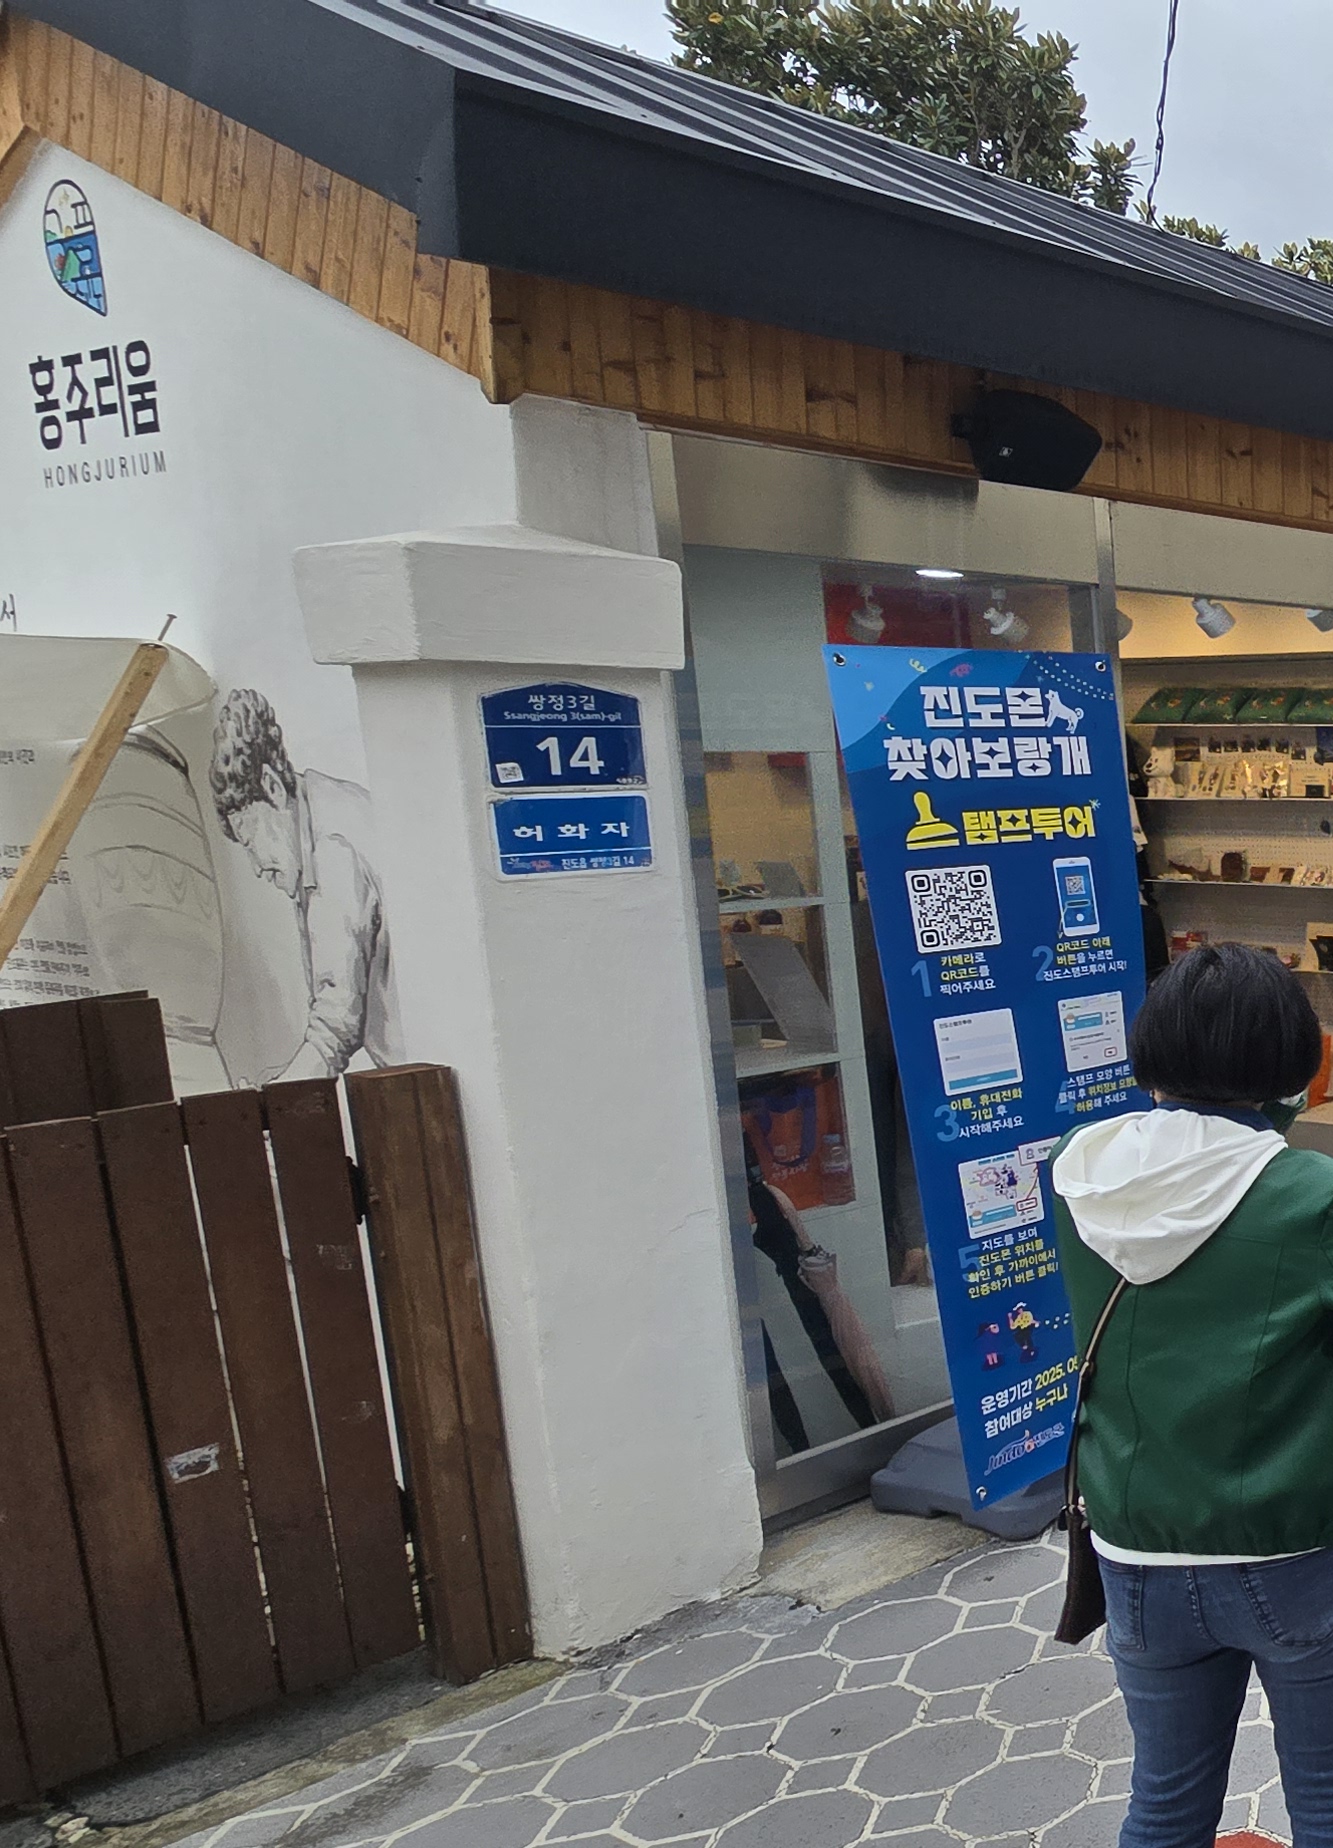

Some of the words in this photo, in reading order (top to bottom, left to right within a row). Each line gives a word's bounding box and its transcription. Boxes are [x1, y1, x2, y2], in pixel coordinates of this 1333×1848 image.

[29, 340, 161, 450] 홍주리움
[43, 450, 167, 488] HONGJURIUM
[528, 695, 595, 711] 쌍정3길
[920, 686, 1047, 728] 진도몬
[504, 712, 568, 722] Ssangjeong
[570, 712, 622, 722] 3(sam)-gil
[536, 736, 605, 776] 14
[883, 736, 1092, 781] 찾아보랑개
[561, 857, 587, 870] 진도읍
[623, 855, 635, 865] 14
[1056, 939, 1090, 952] QR코드
[1092, 936, 1111, 948] 아래
[941, 952, 986, 967] 카메라로
[1032, 945, 1053, 981] 2
[1056, 952, 1085, 965] 버튼을
[1088, 949, 1114, 961] 누르면
[911, 960, 932, 997] 1
[941, 965, 990, 981] QR코드를
[1043, 963, 1106, 981] 진도스탬프투어
[1108, 960, 1127, 972] 시작!
[940, 979, 996, 995] 찍어주세요
[1067, 1073, 1094, 1088] 스탬프
[1096, 1068, 1113, 1081] 모양
[1114, 1064, 1131, 1077] 버튼
[979, 1087, 1022, 1106] 휴대전화
[1058, 1090, 1076, 1104] 클릭
[1078, 1088, 1086, 1102] 후
[1088, 1081, 1117, 1096] 위치정보
[1076, 1097, 1102, 1112] 허용해
[1104, 1091, 1128, 1106] 주세요
[934, 1104, 960, 1142] 3
[971, 1107, 993, 1121] 기입
[996, 1105, 1008, 1117] 후
[959, 1115, 1024, 1138] 시작해주세요
[982, 1234, 1014, 1251] 지도를
[1017, 1227, 1038, 1241] 보며
[979, 1248, 1011, 1267] 진도몬
[1015, 1239, 1044, 1256] 위치를
[968, 1268, 991, 1283] 확인
[994, 1265, 1005, 1276] 후
[1008, 1248, 1056, 1271] 가까이에서
[968, 1276, 1012, 1299] 인증하기
[1014, 1269, 1035, 1283] 버튼
[981, 1378, 1032, 1415] 운영기간
[1035, 1362, 1065, 1390] 2025.
[985, 1401, 1033, 1439] 참여대상
[1035, 1383, 1068, 1412] 누구나
